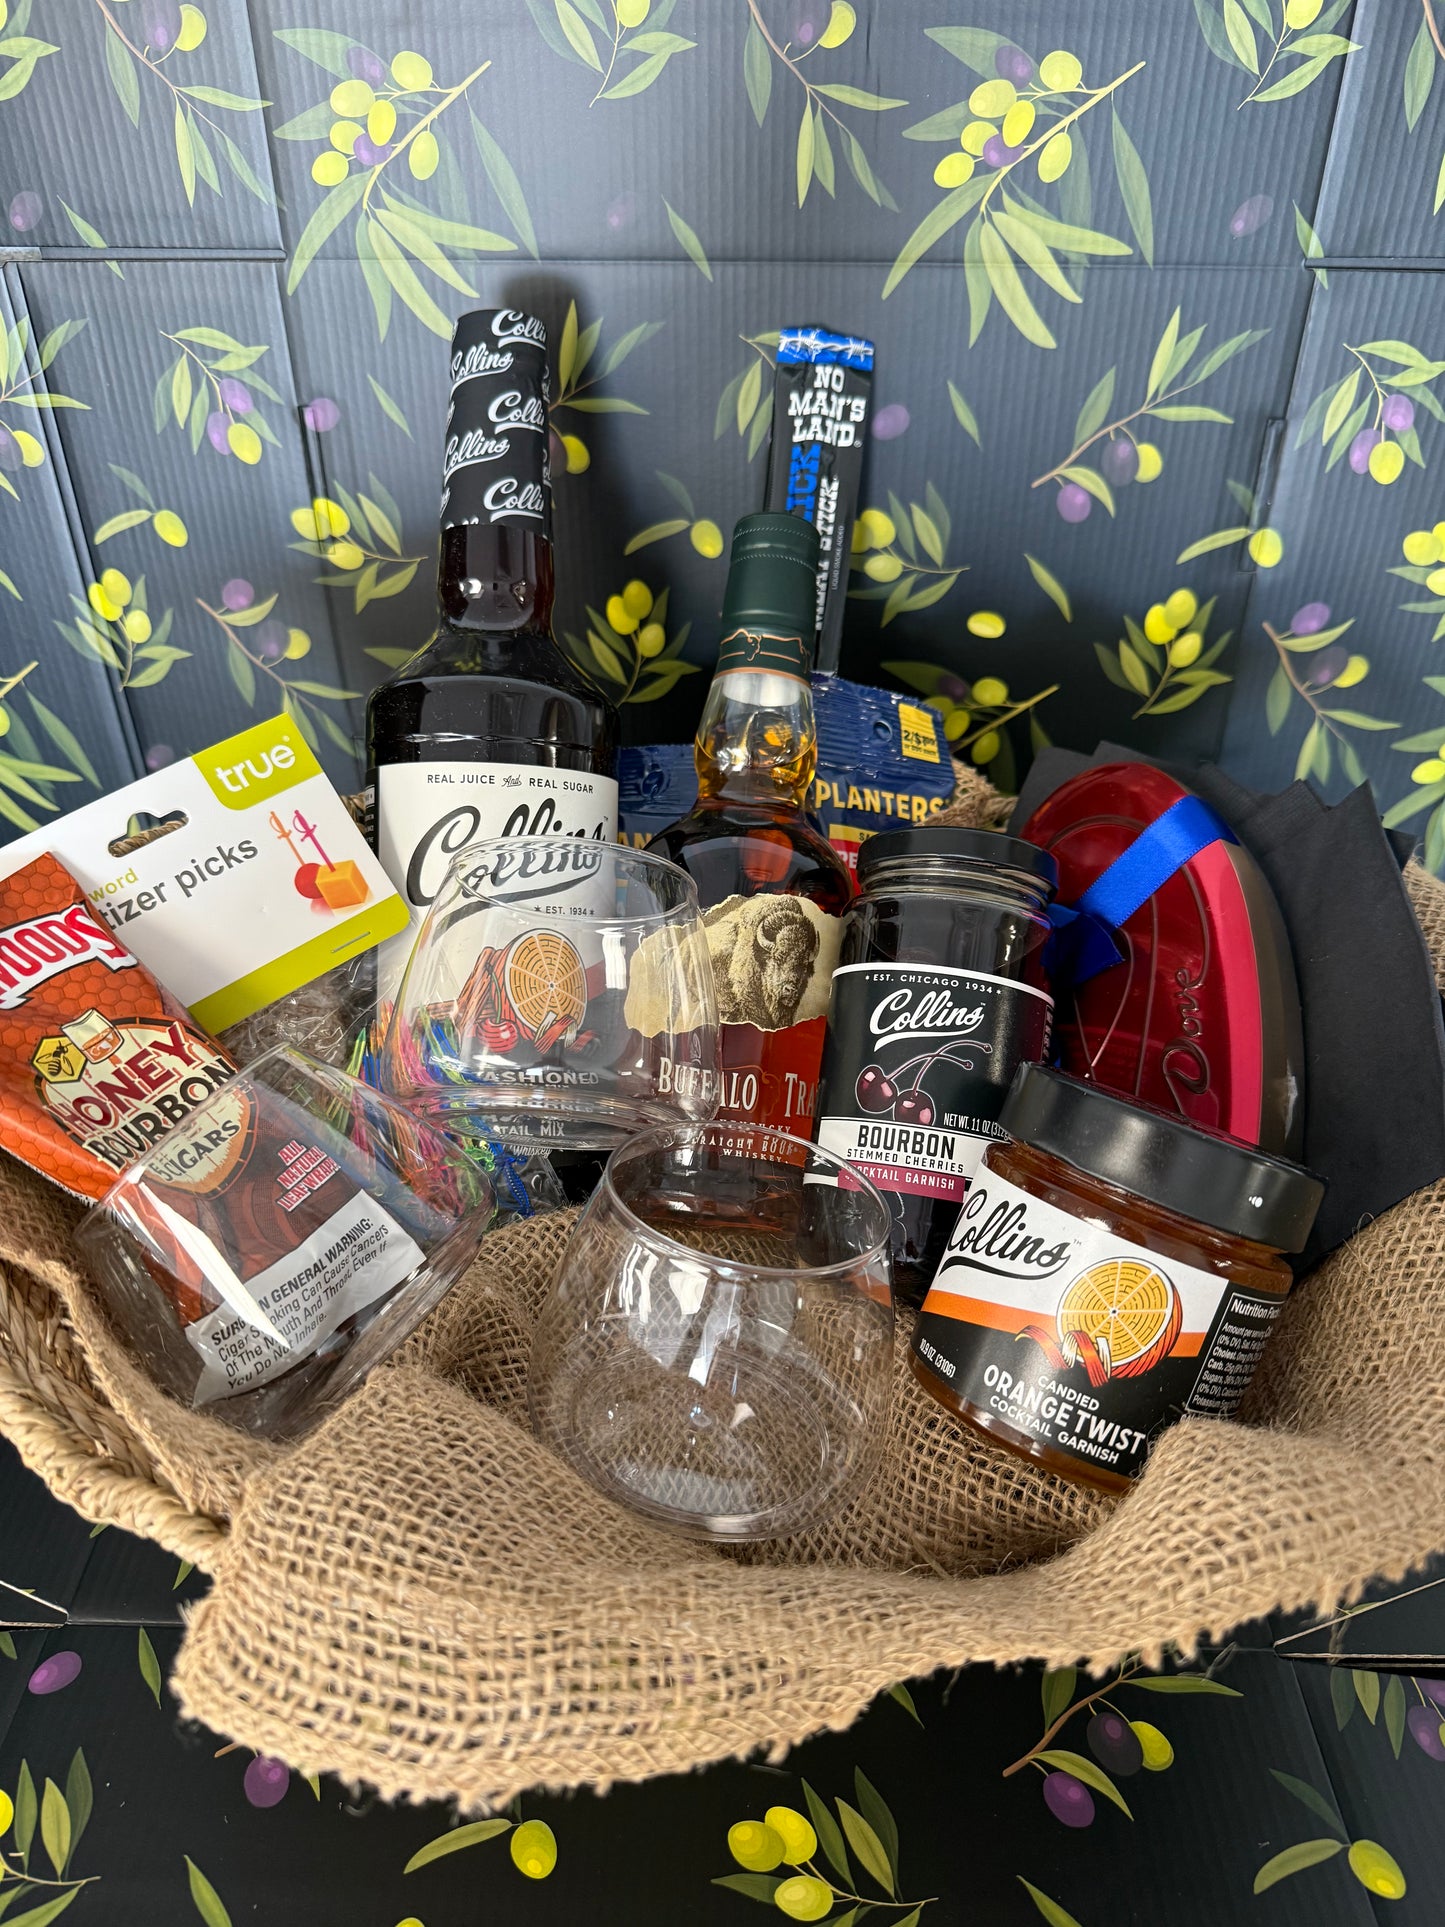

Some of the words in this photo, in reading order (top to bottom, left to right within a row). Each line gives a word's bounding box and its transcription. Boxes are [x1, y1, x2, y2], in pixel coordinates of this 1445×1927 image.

[491, 309, 546, 345] Colli
[451, 342, 513, 385] Collins
[813, 363, 845, 393] NO
[488, 391, 544, 428] Colli
[788, 389, 866, 423] MAN'S
[792, 415, 857, 448] LAND
[444, 429, 510, 475] Collins
[484, 478, 544, 513] Colli
[785, 444, 822, 523] ICK
[215, 741, 298, 794] true
[427, 774, 455, 784] REAL
[460, 774, 496, 785] JUICE
[501, 774, 522, 788] And
[529, 777, 557, 789] REAL
[563, 781, 594, 794] SUGAR
[815, 778, 944, 823] PLANTERS
[406, 797, 608, 908] Collins
[88, 867, 139, 903] word
[98, 881, 168, 931] tizer
[174, 837, 259, 899] picks
[545, 905, 566, 915] EST.
[569, 906, 588, 917] 1934
[873, 973, 894, 982] EST.
[900, 974, 959, 988] CHICAGO
[965, 981, 993, 994] 1934
[869, 988, 985, 1036] Collins
[1161, 967, 1211, 1096] Dove
[50, 1024, 196, 1132] HONEY
[483, 1069, 600, 1085] ASHIONED
[658, 1056, 758, 1111] BUFFALO
[784, 1072, 817, 1118] TRA
[86, 1058, 237, 1168] BOURBON
[501, 1125, 534, 1137] TAIL
[540, 1121, 566, 1138] MIX
[943, 1112, 958, 1127] NET
[958, 1115, 970, 1130] WT.
[971, 1117, 980, 1132] 11
[982, 1119, 991, 1134] OZ
[148, 1162, 174, 1182] 5
[163, 1119, 241, 1177] CIGARS
[278, 1140, 307, 1166] ALL
[722, 1148, 783, 1163] WHISKEY
[857, 1124, 956, 1160] BOURBON
[277, 1145, 327, 1189] NATURAL
[847, 1148, 898, 1163] STEMMED
[905, 1155, 964, 1174] CHERRIES
[855, 1165, 900, 1182] OCKTAIL
[905, 1172, 955, 1190] GARNISH
[277, 1183, 311, 1211] LEAF
[946, 1188, 1072, 1269] Collins
[211, 1295, 270, 1346] SURGN
[270, 1257, 327, 1305] GENERAL
[324, 1217, 374, 1264] WARNING:
[218, 1334, 250, 1363] Cigar
[249, 1297, 301, 1340] Soking
[301, 1280, 323, 1302] Can
[323, 1256, 351, 1284] Cause
[350, 1223, 390, 1258] Cancers
[225, 1359, 240, 1378] Of
[238, 1342, 264, 1365] The
[304, 1294, 324, 1322] And
[322, 1267, 353, 1302] Throat
[352, 1248, 377, 1273] Even
[379, 1240, 388, 1254] If
[1230, 1299, 1269, 1319] Nutrition
[1222, 1321, 1245, 1337] Amount
[227, 1371, 253, 1391] You
[254, 1358, 272, 1376] Do
[273, 1340, 294, 1361] Not
[294, 1311, 328, 1344] Inhale.
[983, 1364, 1074, 1428] ORANGE
[1073, 1410, 1146, 1455] TWIST
[1038, 1375, 1100, 1411] CANDIED
[989, 1395, 1053, 1437] COCKTAIL
[1057, 1431, 1120, 1465] GARNISH
